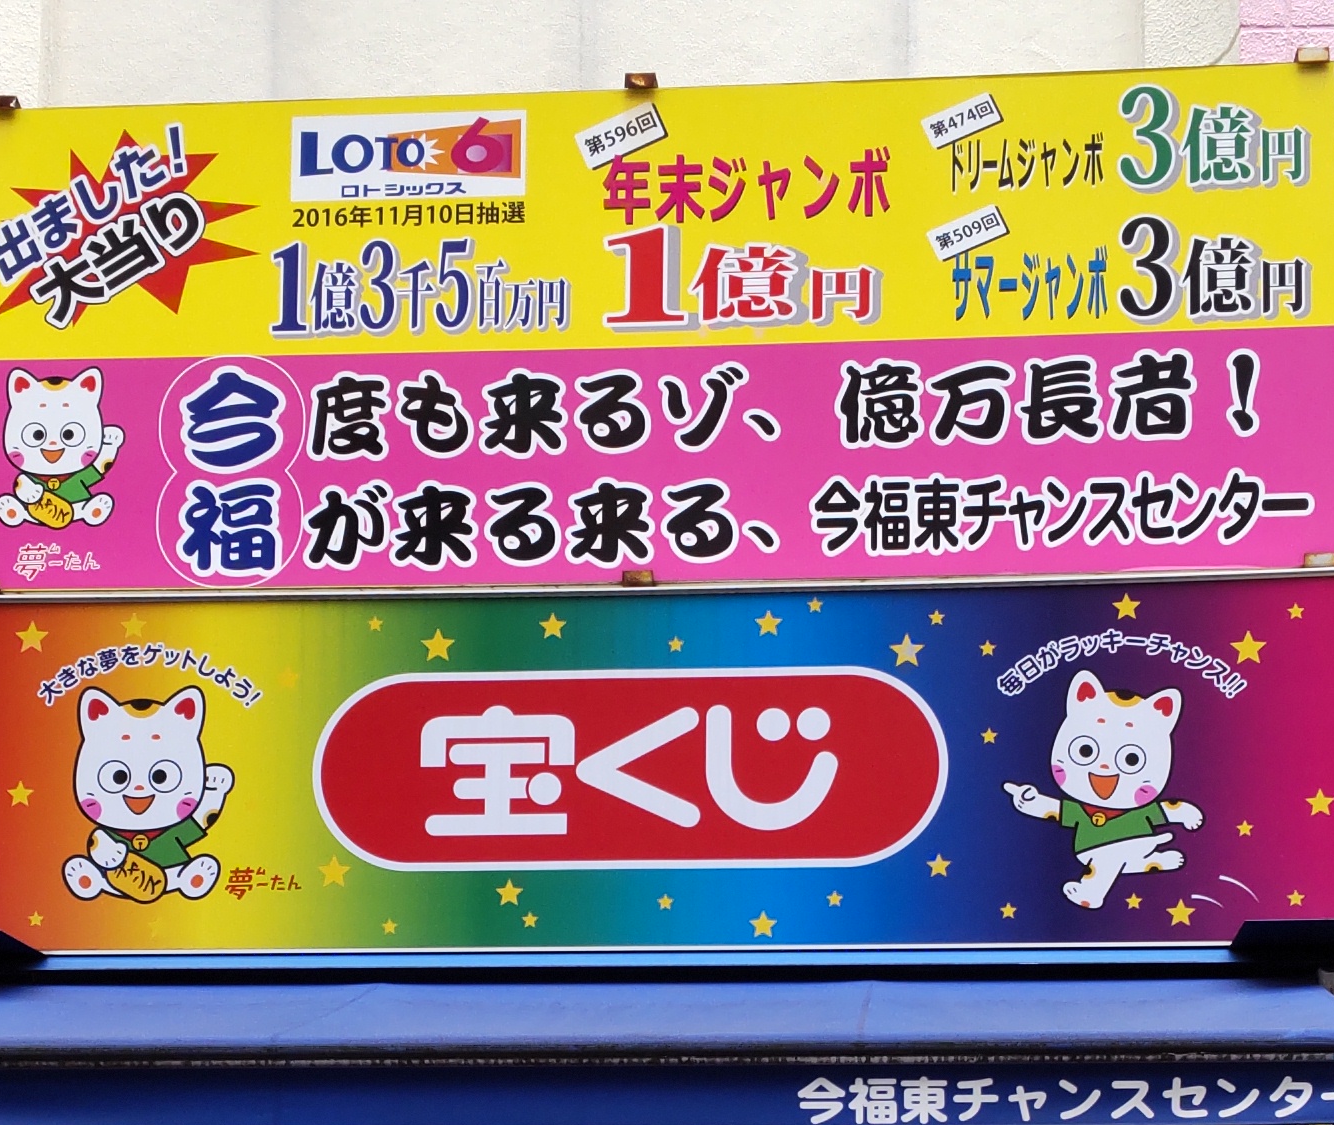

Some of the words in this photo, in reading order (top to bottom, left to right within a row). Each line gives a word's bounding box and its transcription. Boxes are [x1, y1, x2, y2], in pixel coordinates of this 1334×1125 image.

[299, 133, 426, 176] LOTO
[450, 117, 514, 174] 6
[584, 110, 660, 158] 第596回
[930, 100, 998, 139] 第474回
[1119, 84, 1305, 188] 3億円
[340, 183, 467, 196] ロトシックス
[603, 146, 891, 225] 年末ジャンボ
[951, 132, 1104, 193] ドリームジャンボ
[292, 201, 526, 228] 2016年11月10日抽選
[935, 212, 1002, 252] 第509回
[34, 194, 206, 326] 大当り
[271, 237, 569, 336] 1億3千5百万円
[605, 225, 874, 327] 1億円
[952, 245, 1108, 320] サマージャンボ
[1119, 215, 1305, 320] 3億円
[843, 352, 1261, 448] 億万長者!
[183, 484, 779, 572] 福が来る来る、
[814, 474, 1312, 556] 今福東チャンスセンター
[38, 644, 263, 708] 大きな夢をゲットしよう!
[998, 628, 1247, 699] 毎日がラッキーチャンス!!
[419, 704, 839, 837] 宝くじ
